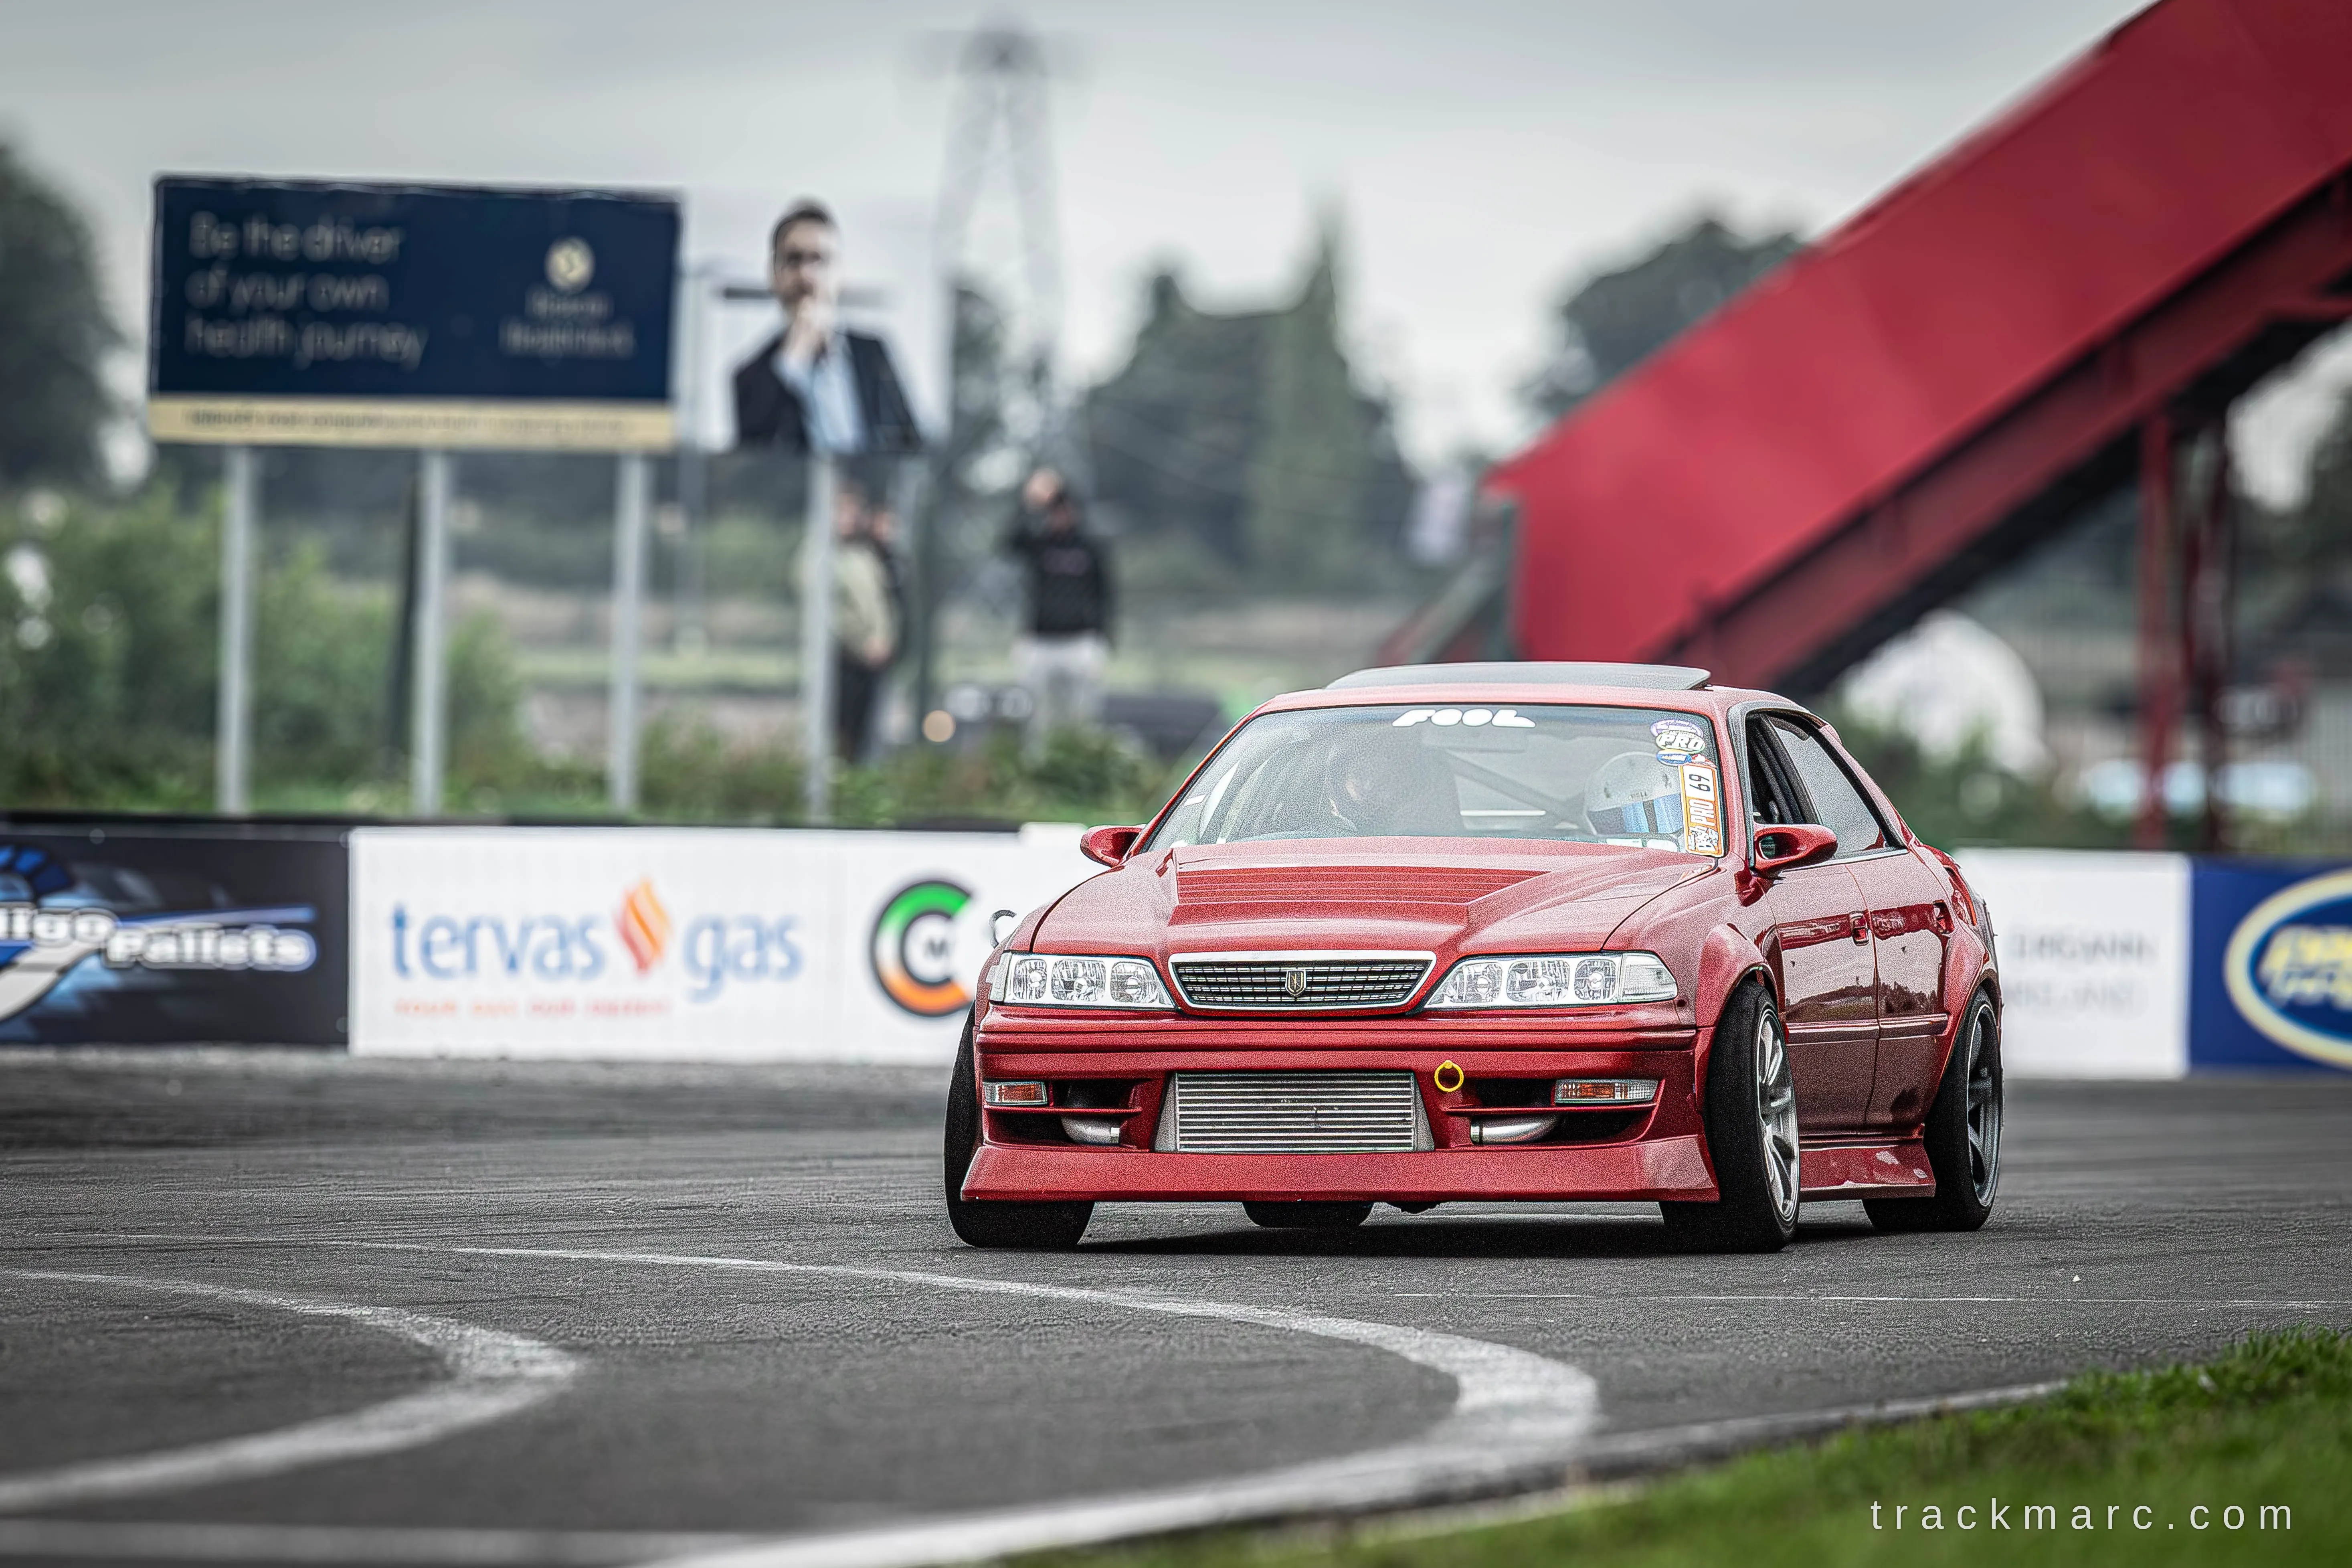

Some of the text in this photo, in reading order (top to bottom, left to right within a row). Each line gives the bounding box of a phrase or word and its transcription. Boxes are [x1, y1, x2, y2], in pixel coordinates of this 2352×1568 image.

[190, 212, 403, 263] Be the driver
[186, 262, 389, 315] of your own
[185, 311, 427, 371] health journey
[1659, 733, 1705, 751] PRO
[1689, 774, 1711, 792] 69
[1689, 799, 1716, 826] PRO
[107, 927, 309, 965] Pallets
[391, 902, 804, 1003] tervas gas
